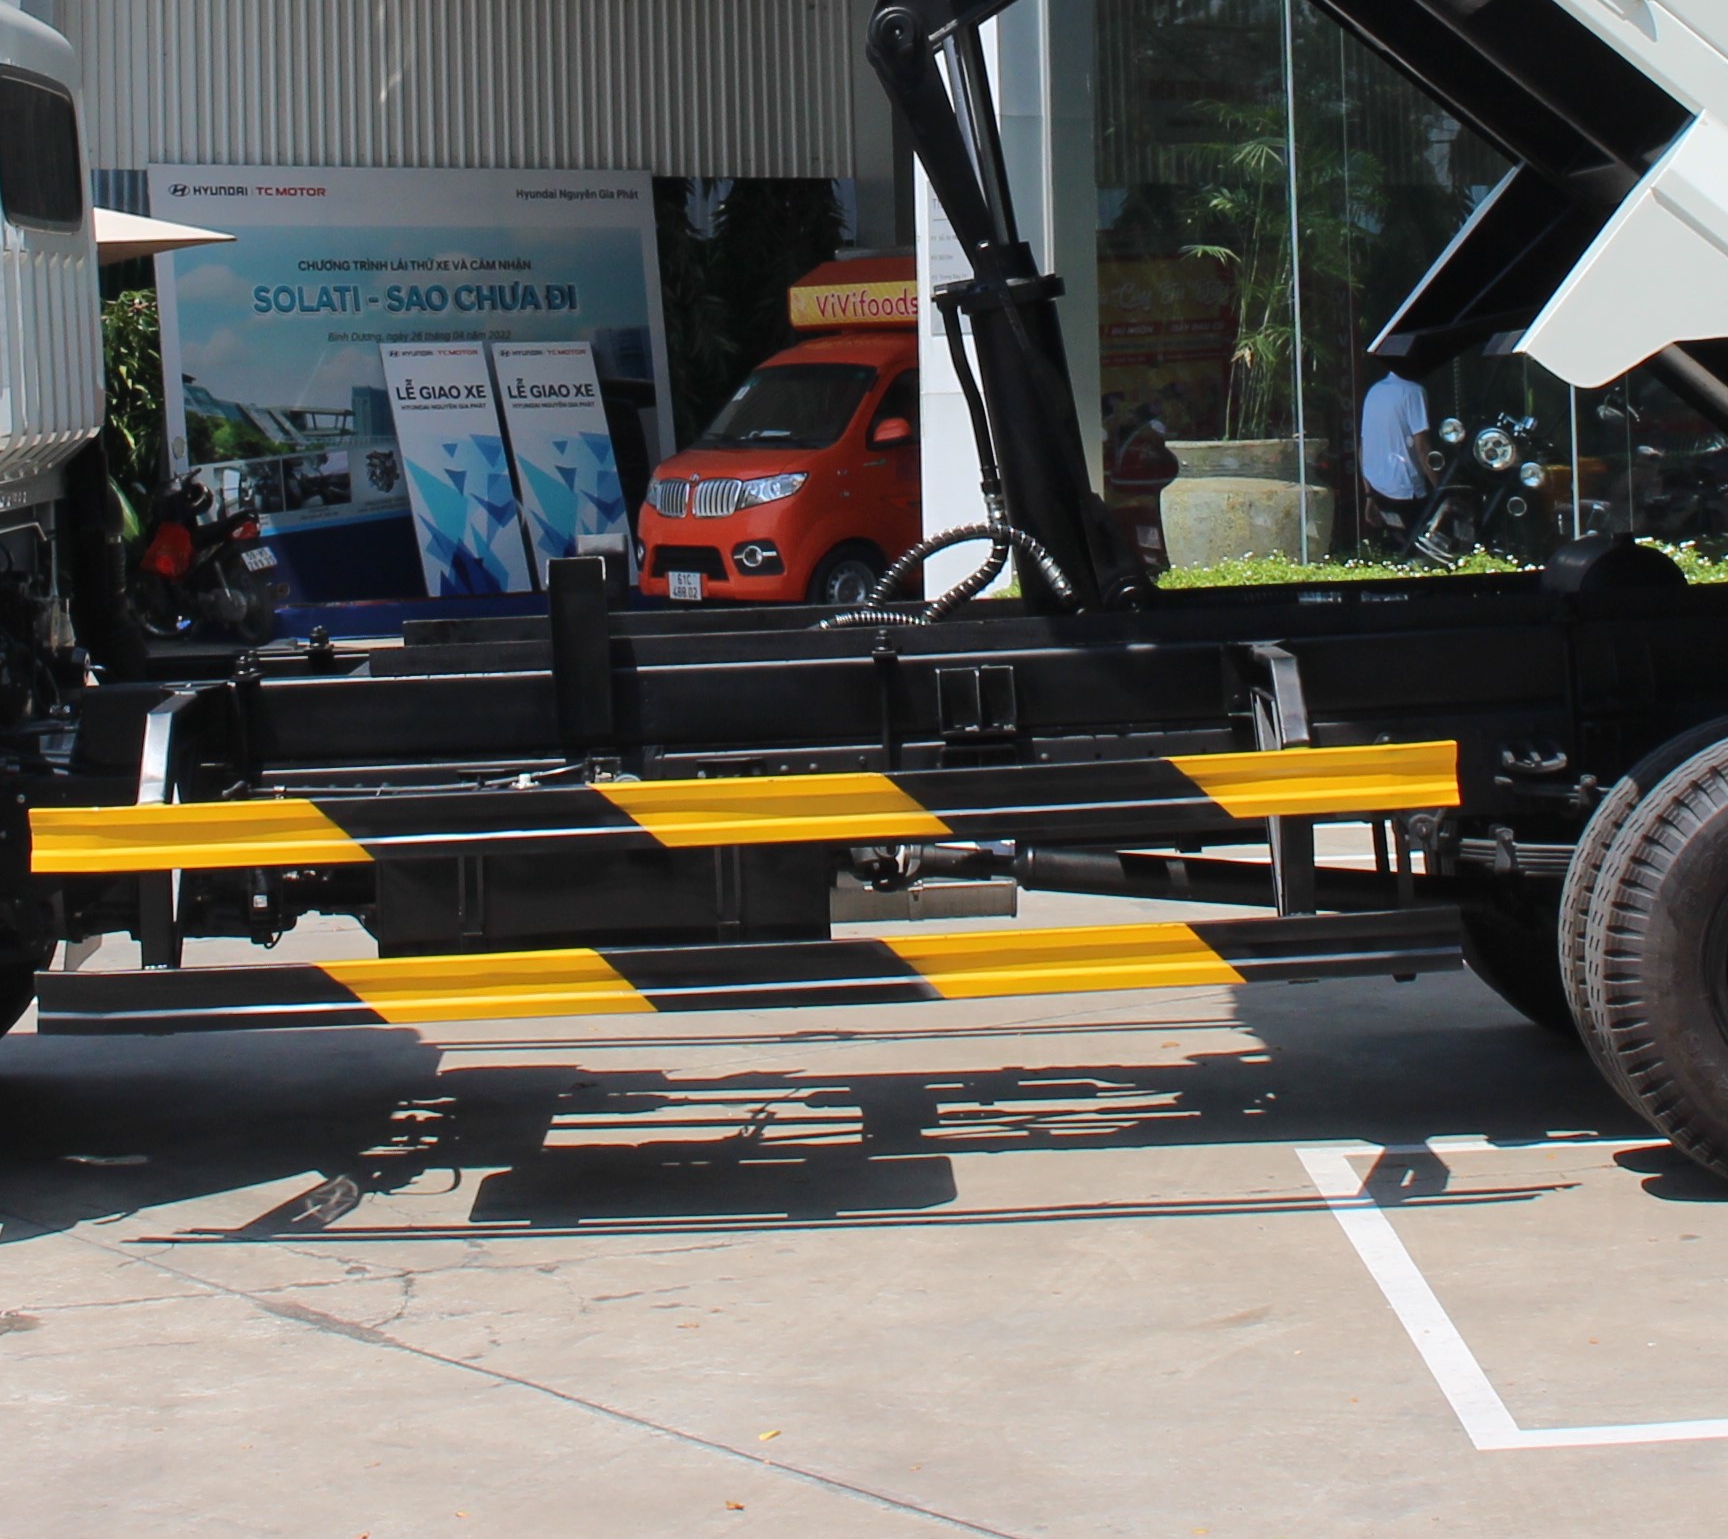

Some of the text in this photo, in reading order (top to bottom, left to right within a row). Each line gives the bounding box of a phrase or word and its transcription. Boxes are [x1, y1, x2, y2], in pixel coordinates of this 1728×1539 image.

[193, 186, 326, 197] HYUNDAI TC MOTOR
[516, 189, 558, 201] Hyundai
[599, 189, 615, 200] Gia
[617, 189, 639, 200] Phát
[436, 260, 450, 271] XE
[452, 259, 469, 271] VÀ
[253, 285, 360, 312] SOLATI
[387, 284, 449, 312] SAO
[454, 281, 541, 312] CHƯA
[546, 283, 578, 312] ĐI
[816, 288, 918, 318] ViVifoods
[396, 379, 487, 400] LỄ GIAO XE
[507, 378, 595, 400] LỄ GIAO XE
